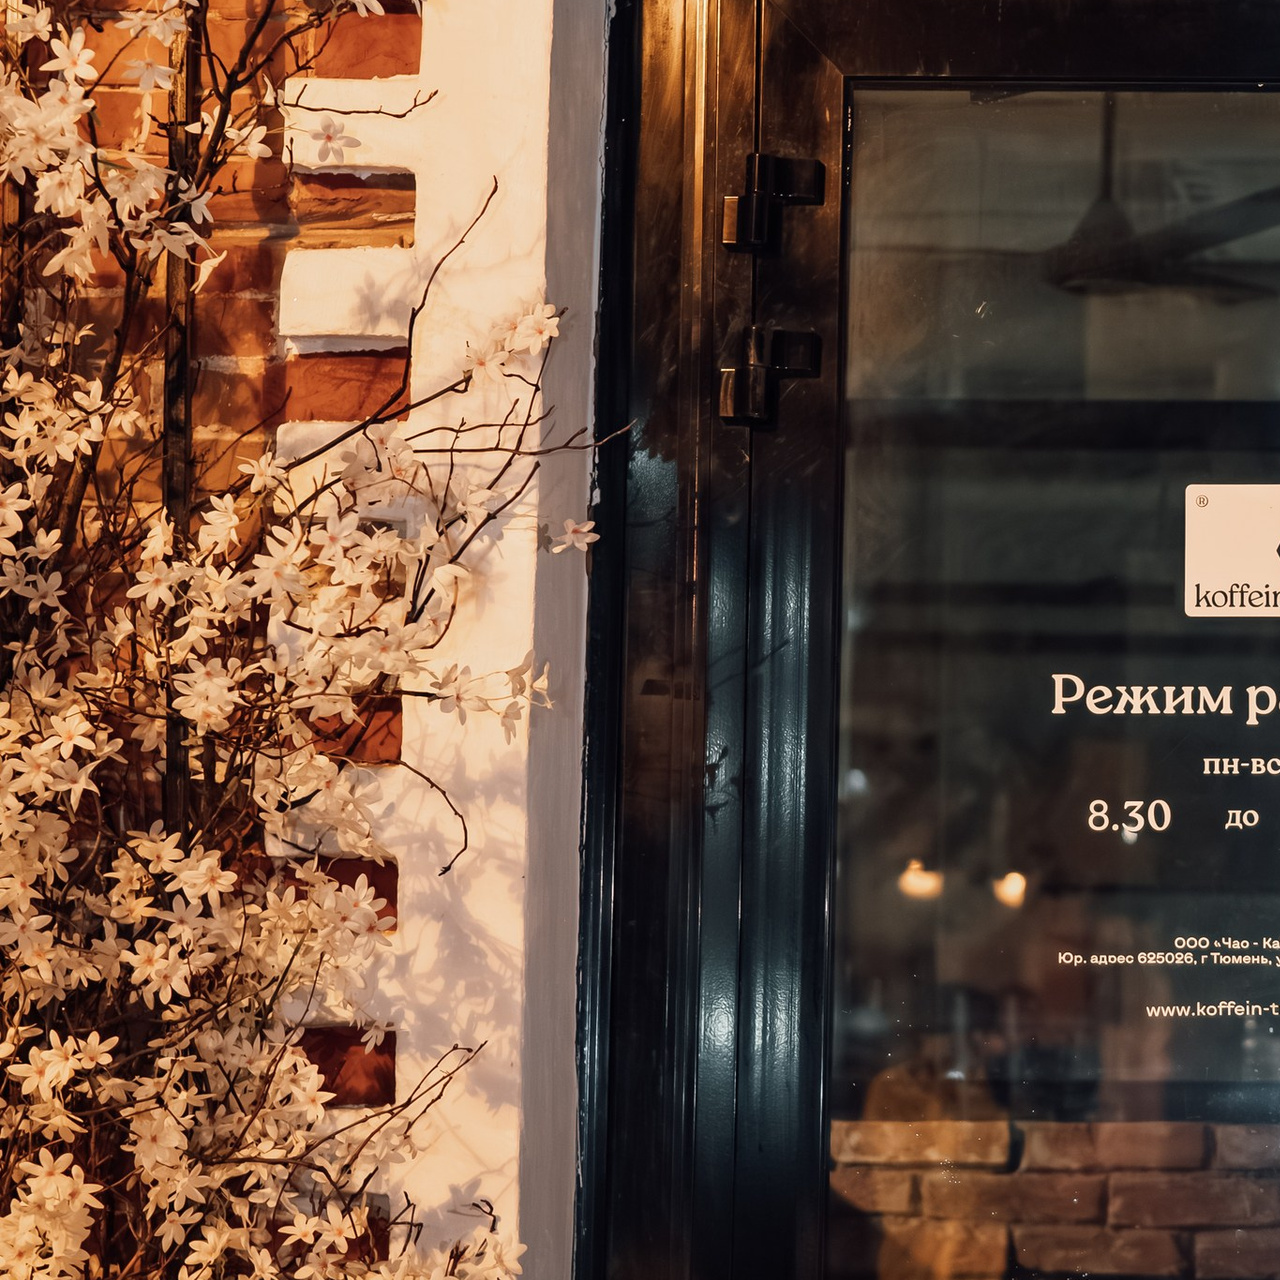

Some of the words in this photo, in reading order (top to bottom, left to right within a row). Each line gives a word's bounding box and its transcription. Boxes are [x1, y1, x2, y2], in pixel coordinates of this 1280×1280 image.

[1051, 673, 1233, 714] Режим
[1087, 799, 1172, 832] 8.30
[1224, 809, 1260, 830] до
[1174, 936, 1210, 949] ООО
[1213, 937, 1250, 949] «Чао
[1058, 952, 1087, 966] Юр.
[1090, 955, 1134, 966] адрес
[1137, 952, 1198, 966] 625026,
[1201, 955, 1208, 964] г
[1210, 952, 1272, 966] Тюмень,
